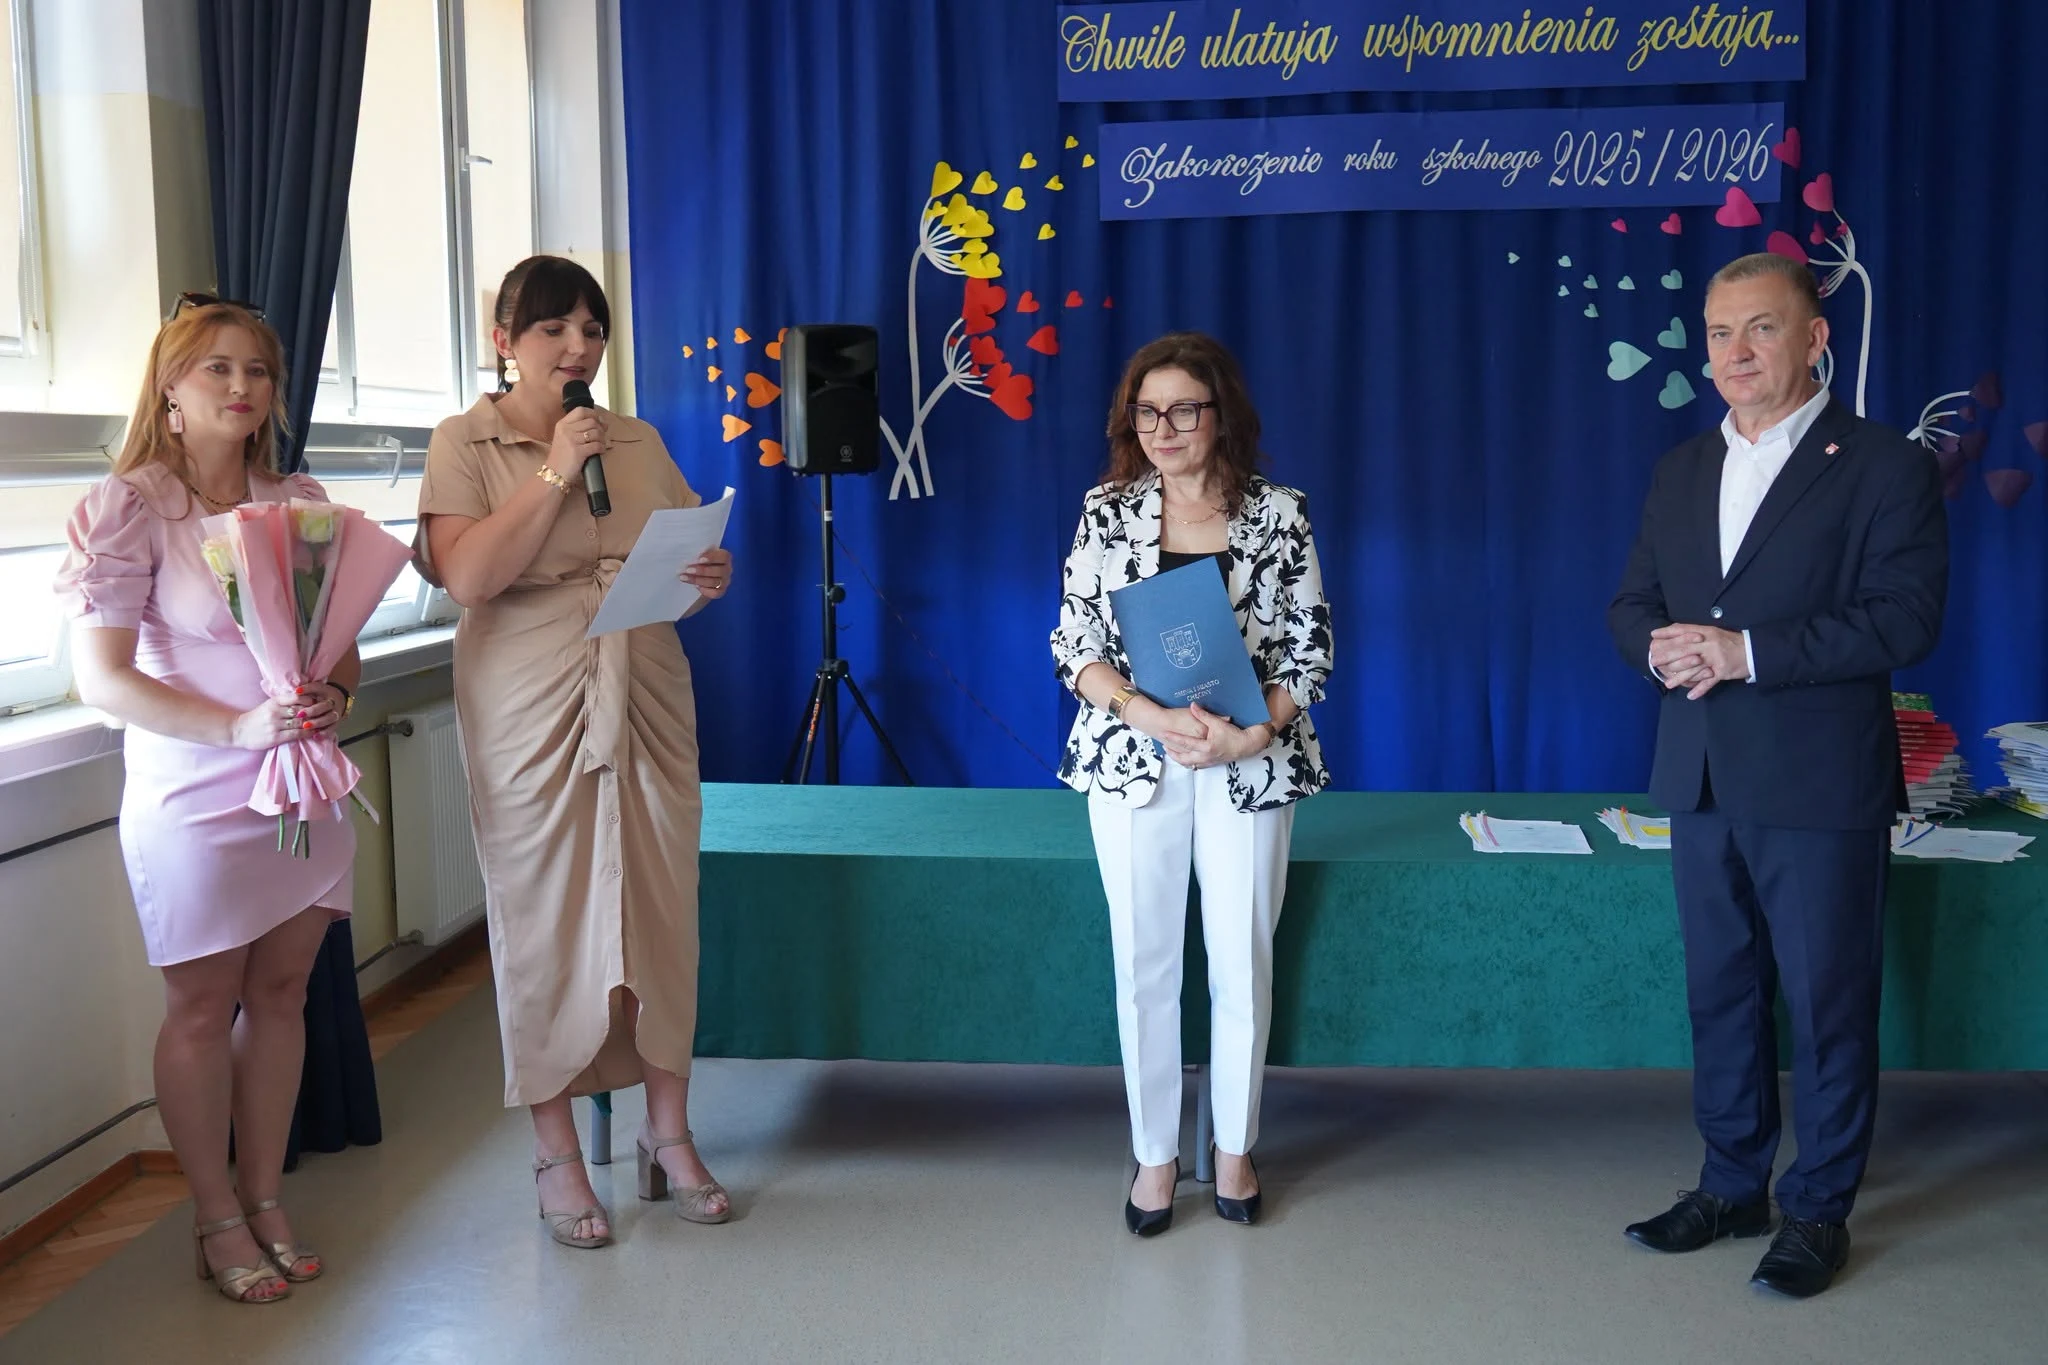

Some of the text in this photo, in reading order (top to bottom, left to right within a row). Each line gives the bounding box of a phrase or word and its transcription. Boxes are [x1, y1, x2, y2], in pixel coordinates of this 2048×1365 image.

[1060, 11, 1186, 73] Chwile
[1363, 7, 1620, 73] wspomnienia
[1120, 143, 1323, 208] Zakończenie
[1343, 139, 1398, 172] roku
[1422, 139, 1543, 188] szkolnego
